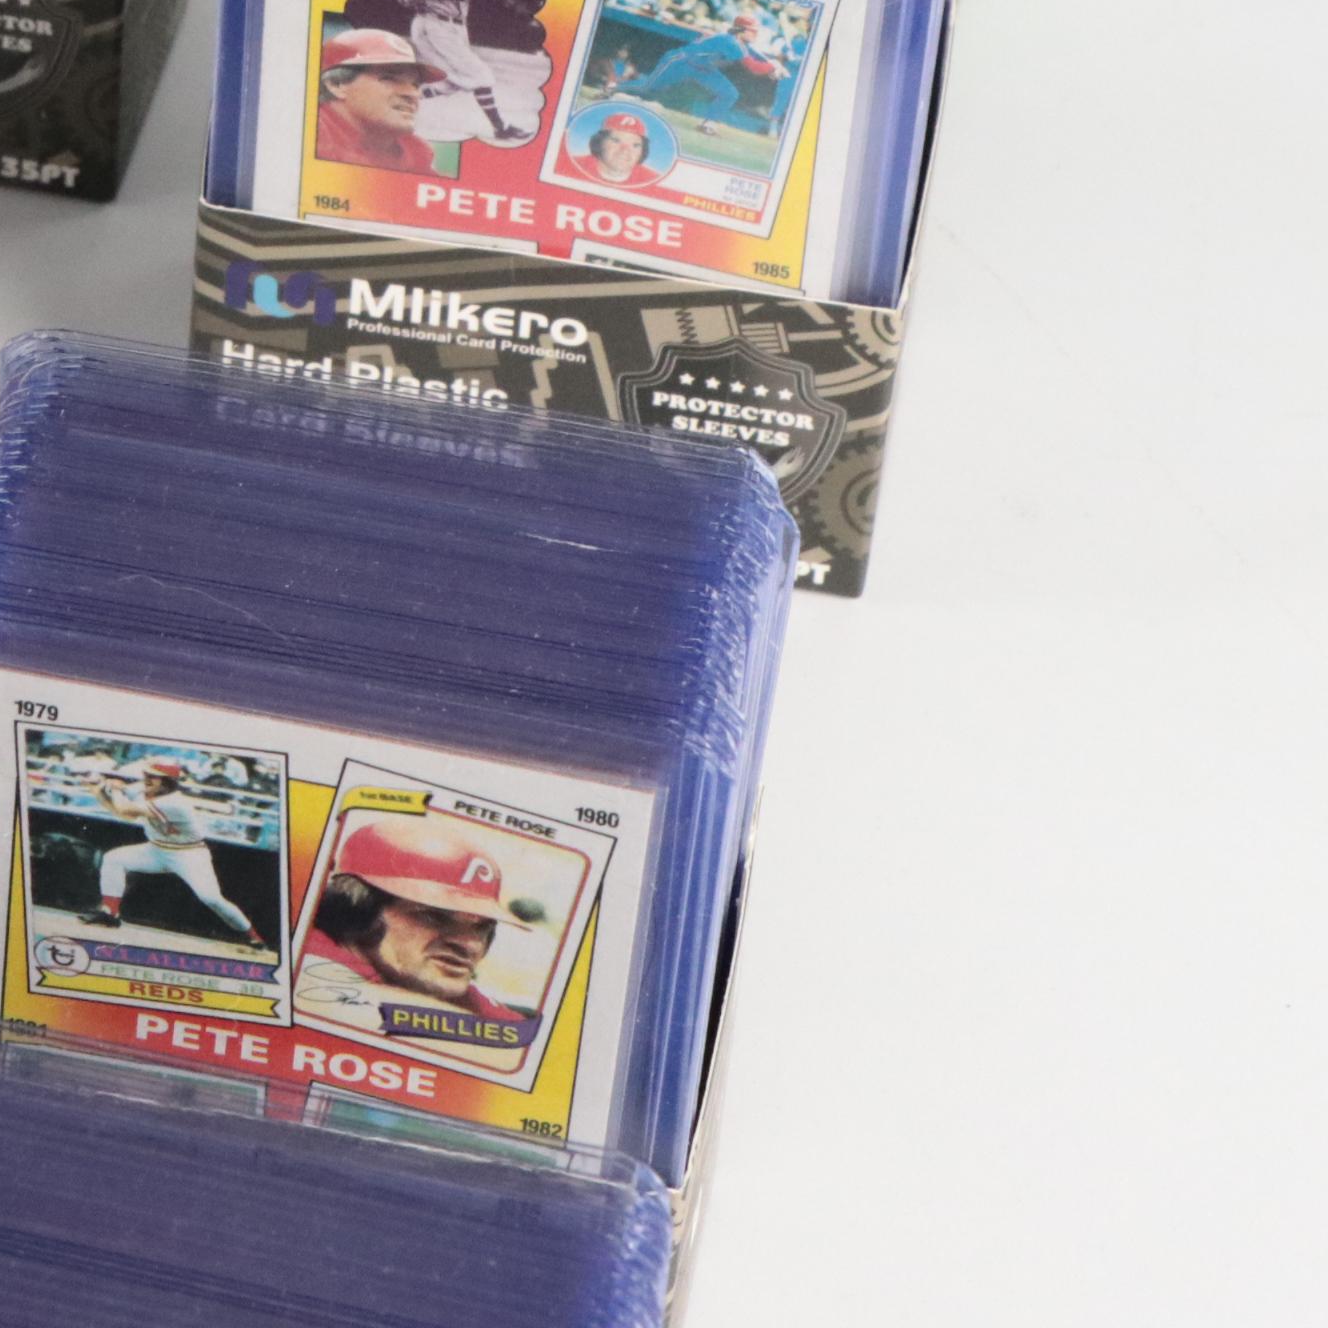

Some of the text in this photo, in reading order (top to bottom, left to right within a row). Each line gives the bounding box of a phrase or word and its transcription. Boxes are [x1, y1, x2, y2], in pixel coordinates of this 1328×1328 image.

[0, 155, 80, 188] 35PT
[313, 194, 351, 212] 1984
[416, 182, 684, 249] PETE ROSE
[683, 194, 757, 223] PHILLIES
[753, 260, 791, 280] 1985
[347, 317, 587, 365] Professional Card Protection
[222, 339, 509, 412] Hard Plastic
[652, 391, 815, 431] PROTECTOR
[672, 415, 791, 447] SLEEVES
[795, 560, 831, 585] PT
[14, 699, 59, 722] 1979
[453, 800, 557, 839] PETE ROSE
[574, 806, 620, 828] 1980
[101, 963, 159, 982] PETE
[162, 971, 220, 991] ROSE
[128, 981, 205, 1004] REDS
[392, 1010, 520, 1044] PHILLIES
[135, 1013, 438, 1099] PETE ROSE
[519, 1116, 564, 1139] 1982
